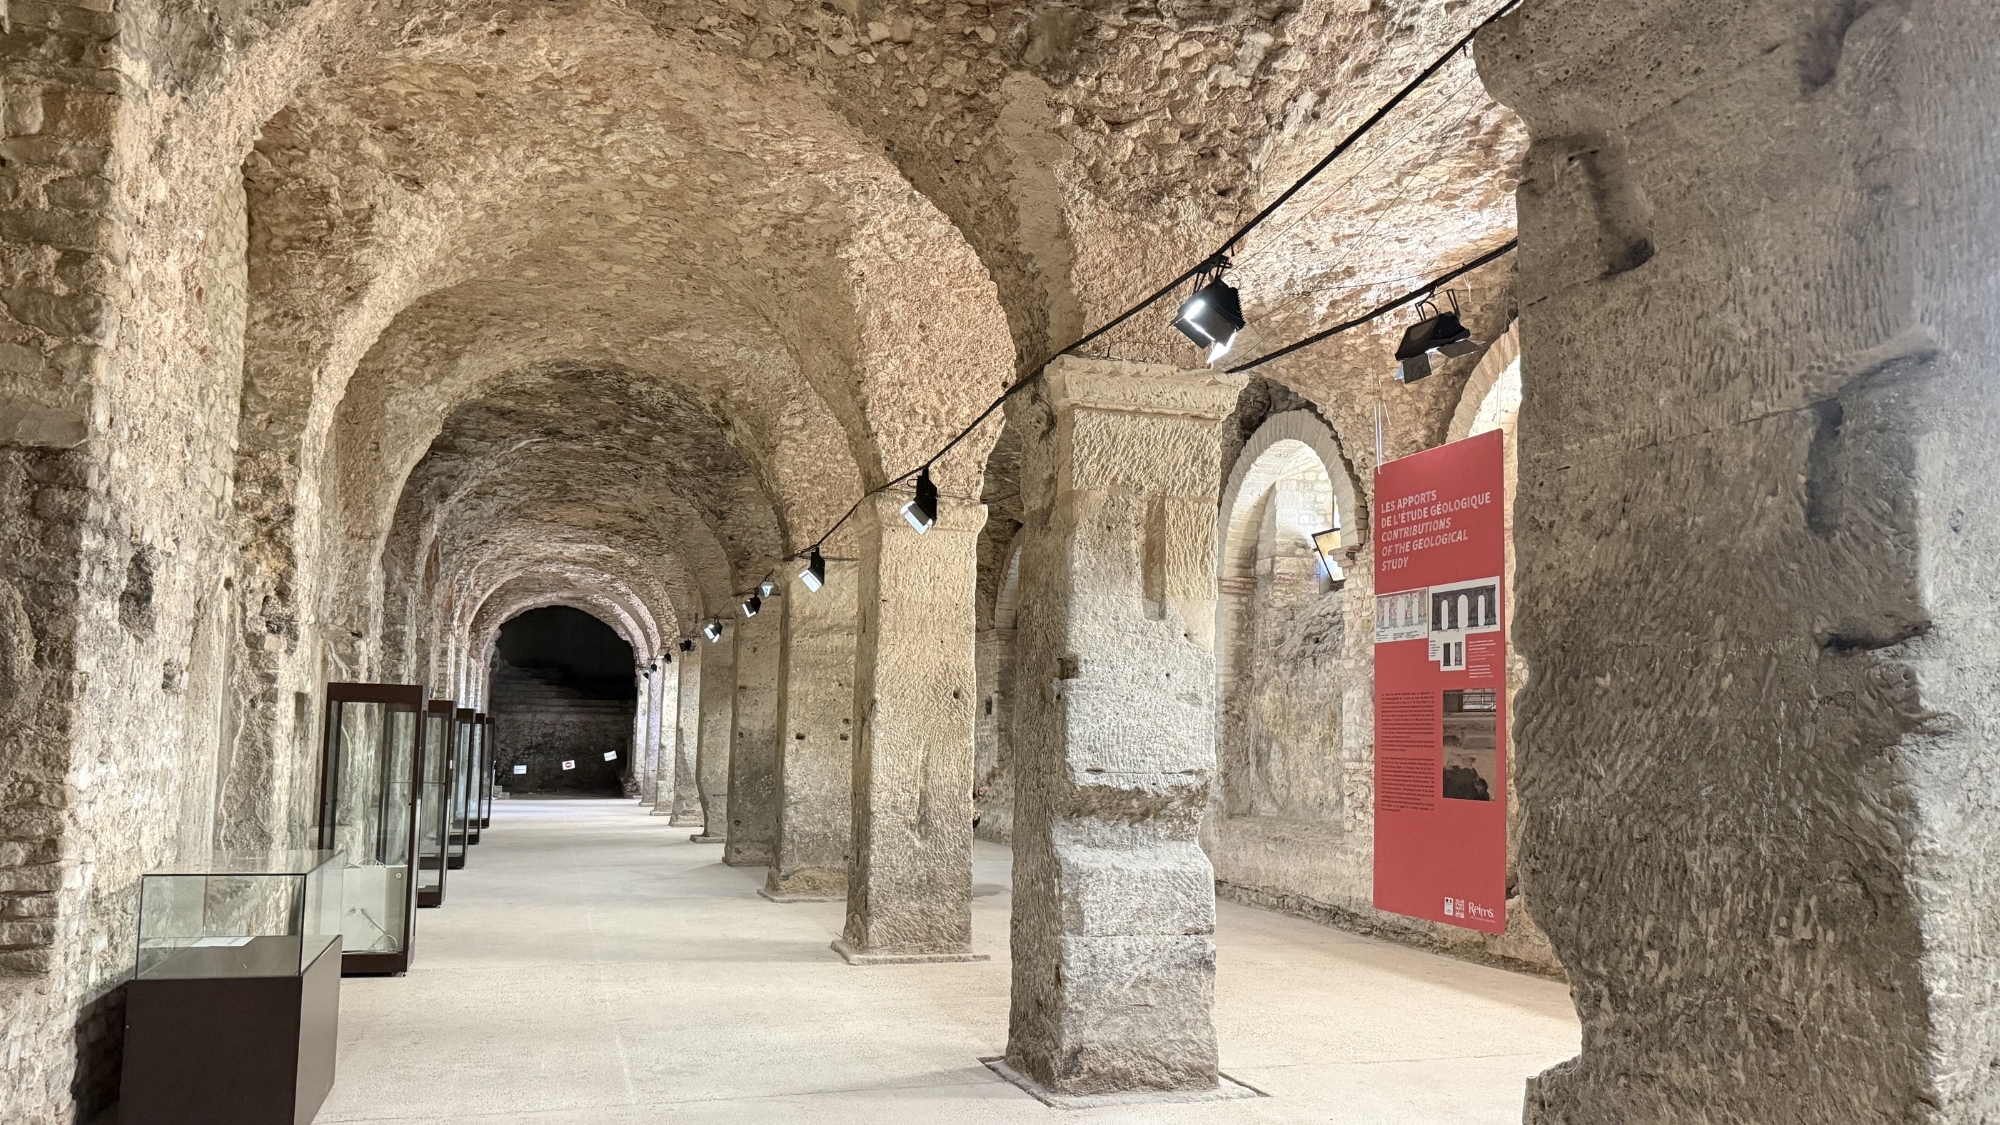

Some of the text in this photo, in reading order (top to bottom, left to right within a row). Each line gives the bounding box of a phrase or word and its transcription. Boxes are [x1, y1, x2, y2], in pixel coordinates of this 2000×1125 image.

[1381, 490, 1437, 514] LES APPORTS
[1381, 516, 1392, 528] DE
[1430, 492, 1491, 516] GÉOLOGIQUE
[1381, 517, 1451, 543] CONTRIBUTIONS
[1382, 529, 1468, 557] OF THE GEOLOGICAL
[1381, 556, 1409, 571] STUDY
[1469, 902, 1494, 918] Reims
